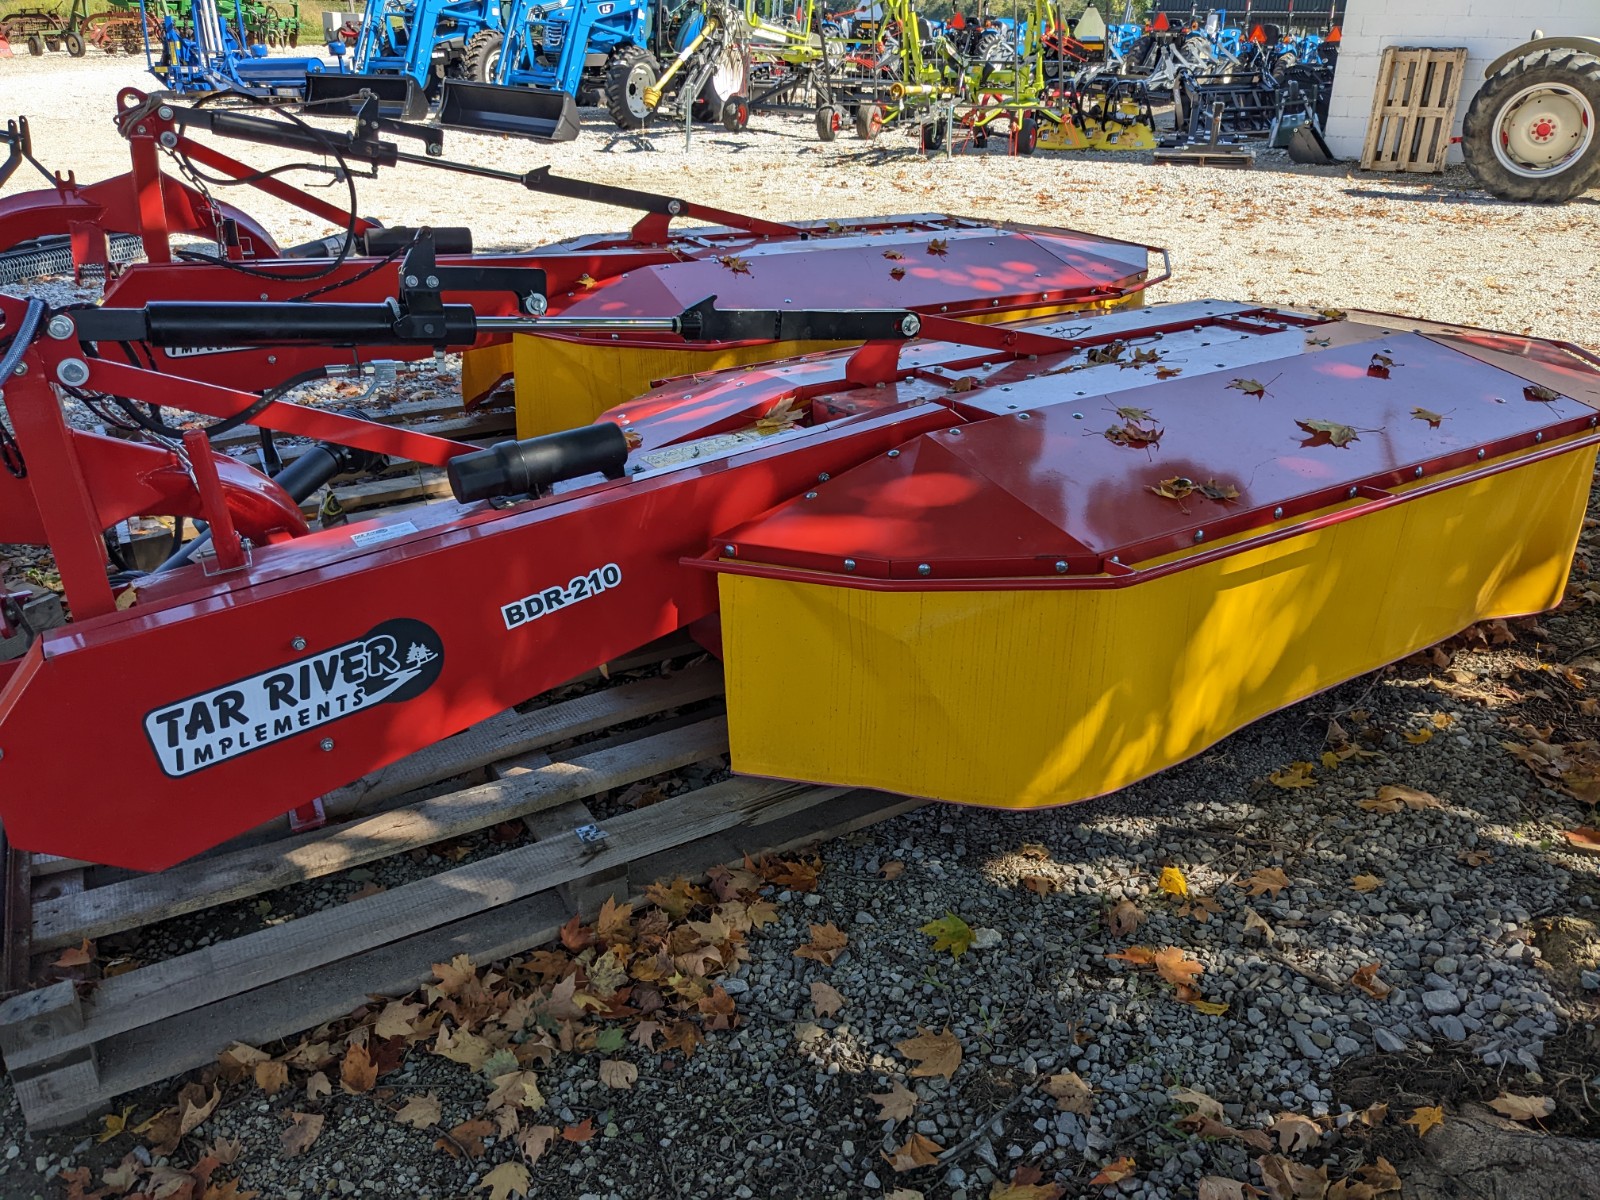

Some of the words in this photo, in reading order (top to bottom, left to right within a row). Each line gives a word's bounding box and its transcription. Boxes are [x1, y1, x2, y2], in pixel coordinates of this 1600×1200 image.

[602, 4, 611, 13] LS
[504, 565, 619, 627] BDR-210
[156, 690, 250, 748] TAR
[263, 635, 400, 710] RIVER
[176, 688, 365, 771] IMPLEMENTS
